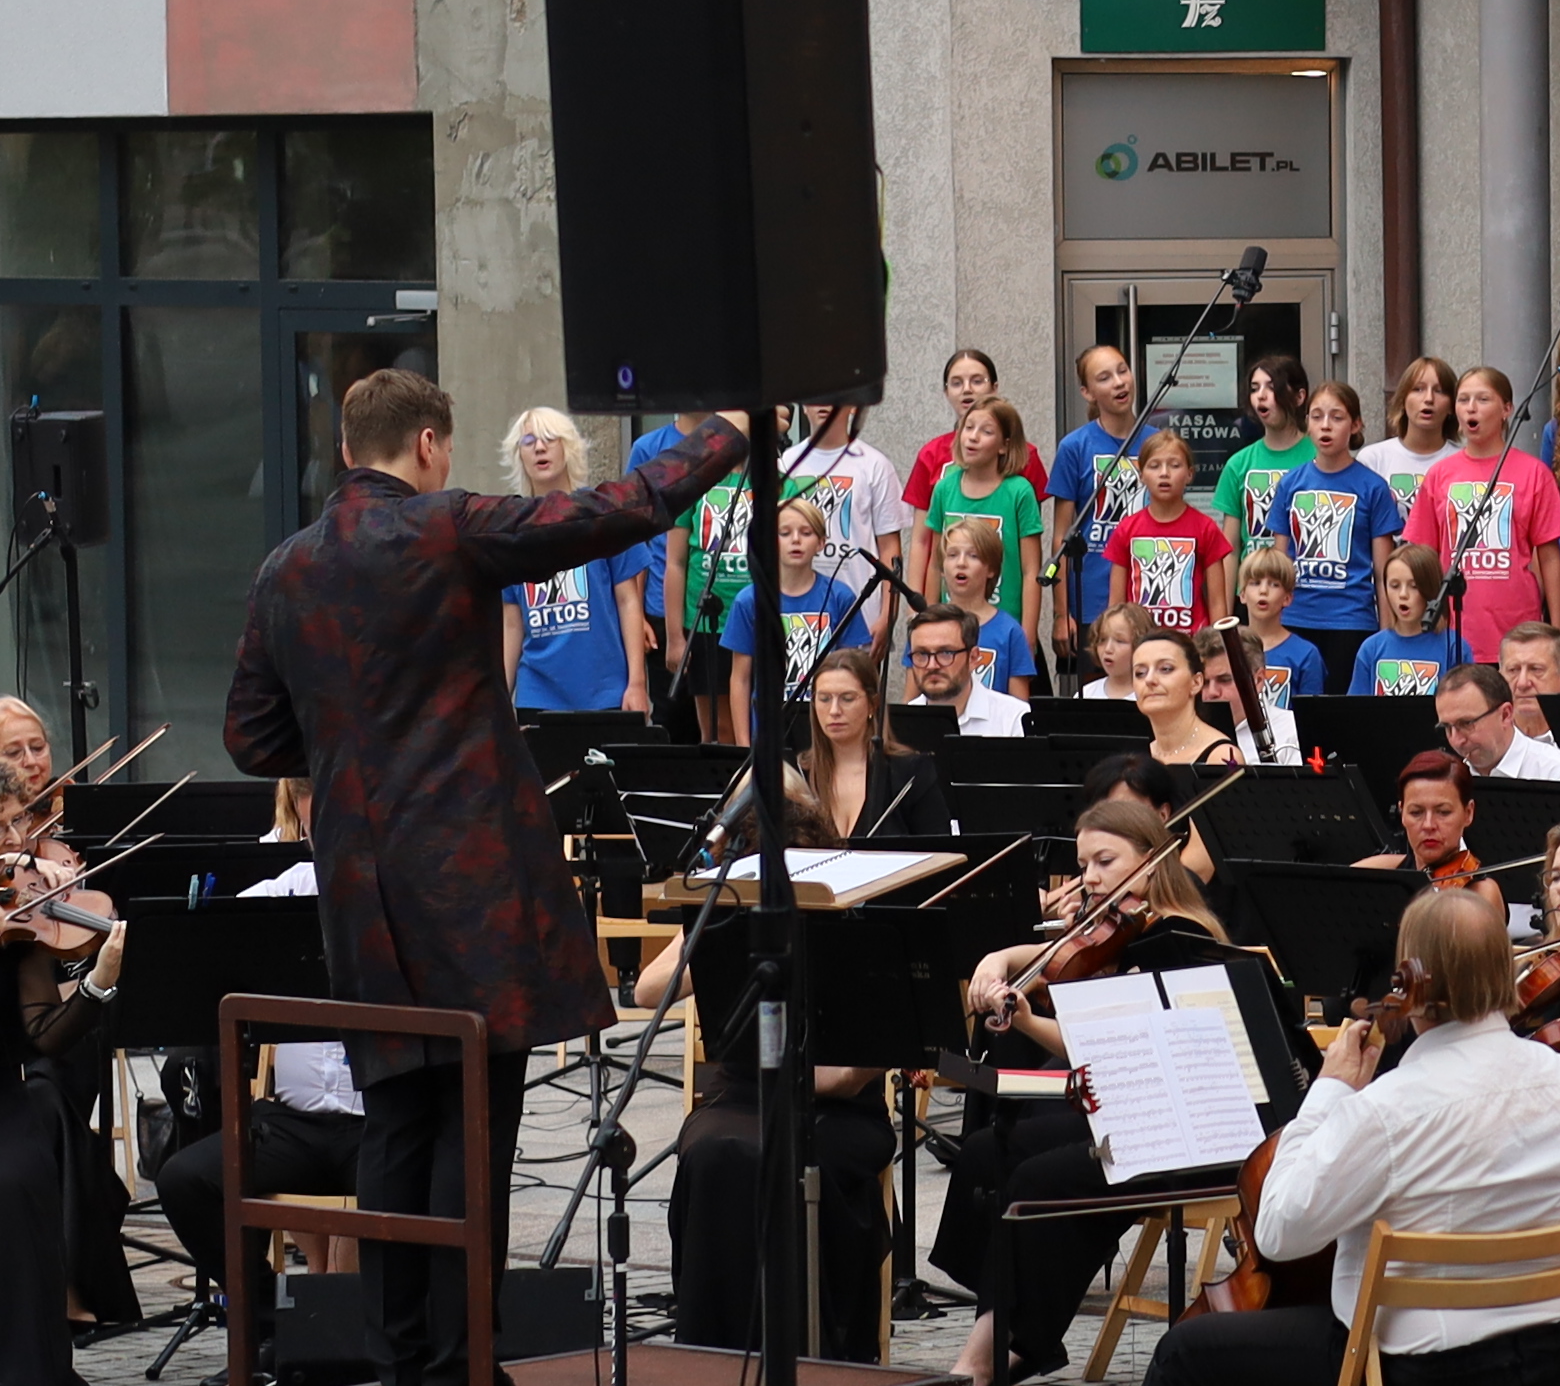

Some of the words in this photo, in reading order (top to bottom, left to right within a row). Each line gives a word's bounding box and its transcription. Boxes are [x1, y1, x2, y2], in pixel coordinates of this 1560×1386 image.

[1147, 152, 1300, 172] ABILET.PL
[1168, 414, 1217, 427] KASA
[528, 602, 590, 628] artos
